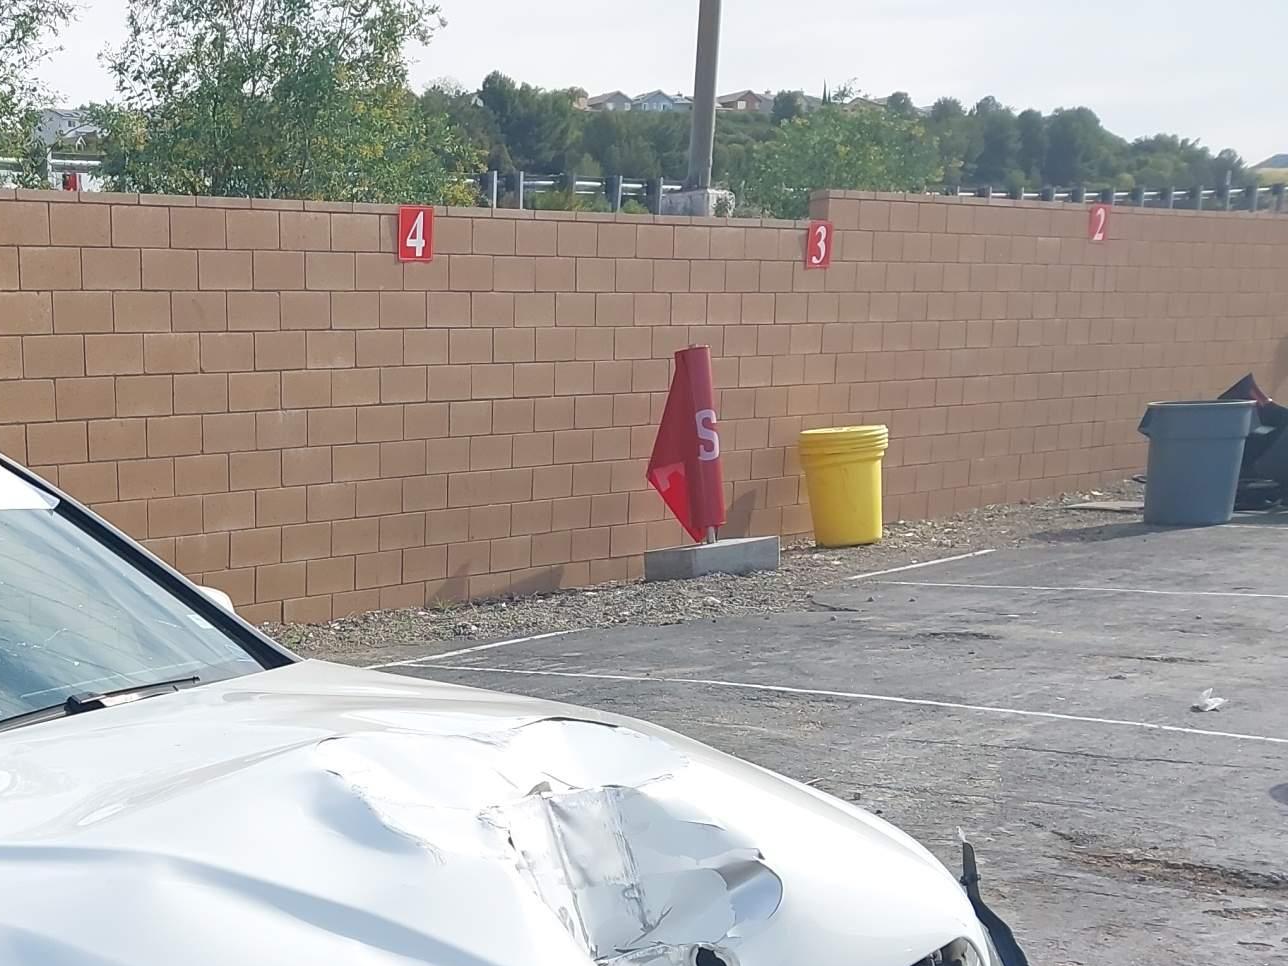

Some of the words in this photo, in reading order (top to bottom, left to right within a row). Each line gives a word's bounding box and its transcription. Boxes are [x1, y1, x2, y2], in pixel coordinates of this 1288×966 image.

[406, 212, 425, 256] 4
[812, 226, 827, 263] 3
[1093, 209, 1105, 240] 2
[695, 409, 720, 460] S
